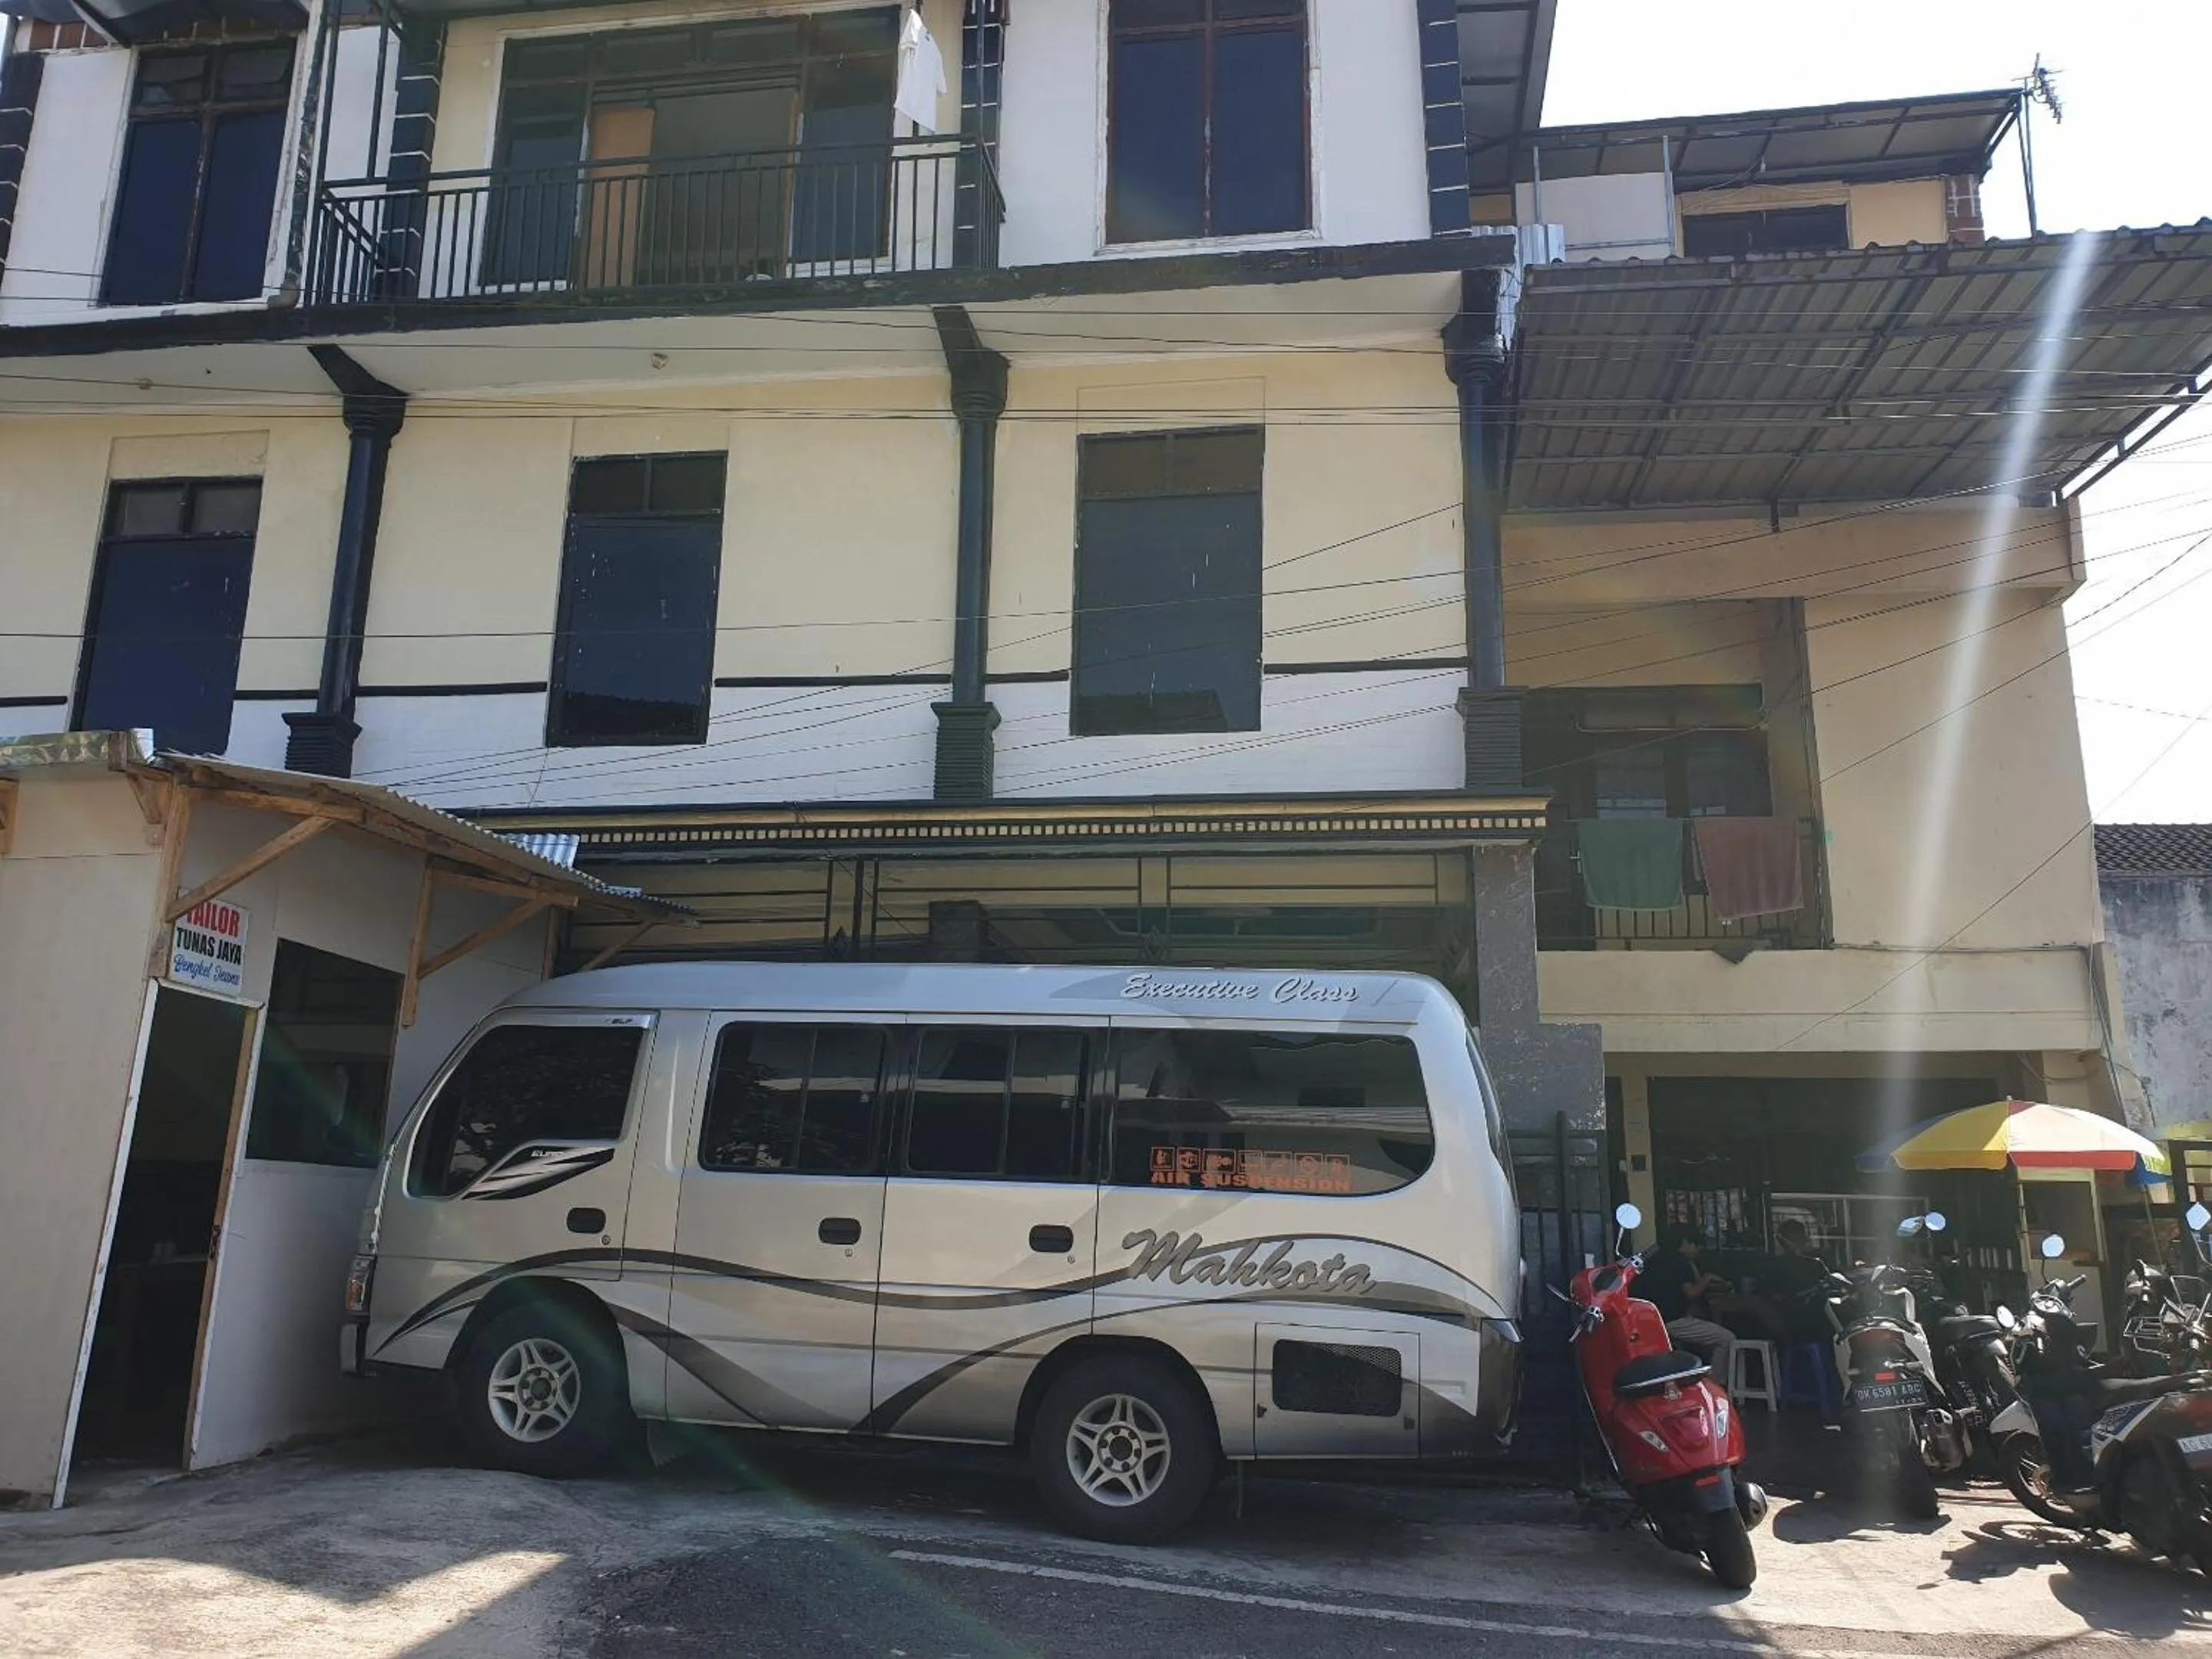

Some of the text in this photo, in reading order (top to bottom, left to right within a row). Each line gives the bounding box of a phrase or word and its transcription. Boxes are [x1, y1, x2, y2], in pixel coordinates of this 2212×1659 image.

[177, 926, 241, 965] TUNAS JAYA
[174, 954, 213, 979] Bengkel
[1121, 972, 1360, 1005] Executive Class
[1151, 1172, 1352, 1191] AIR SUSPENSION
[1121, 1228, 1379, 1295] Mahkota
